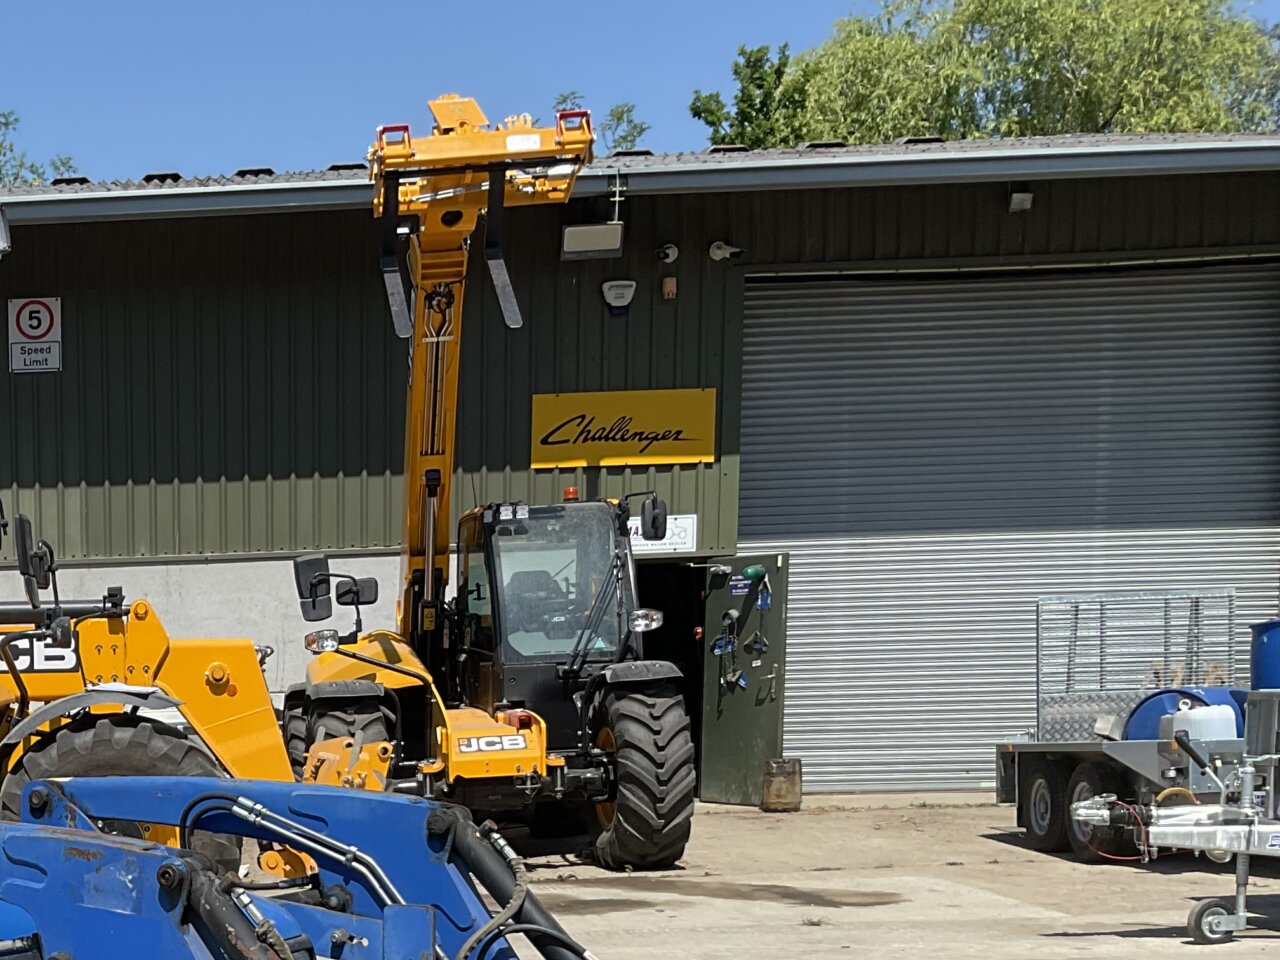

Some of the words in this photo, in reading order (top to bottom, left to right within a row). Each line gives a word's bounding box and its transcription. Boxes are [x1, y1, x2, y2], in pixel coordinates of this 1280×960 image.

[28, 310, 42, 330] 5
[20, 345, 52, 355] Speed
[23, 357, 49, 367] Limit
[540, 414, 704, 453] Challenger
[459, 735, 526, 753] JCB
